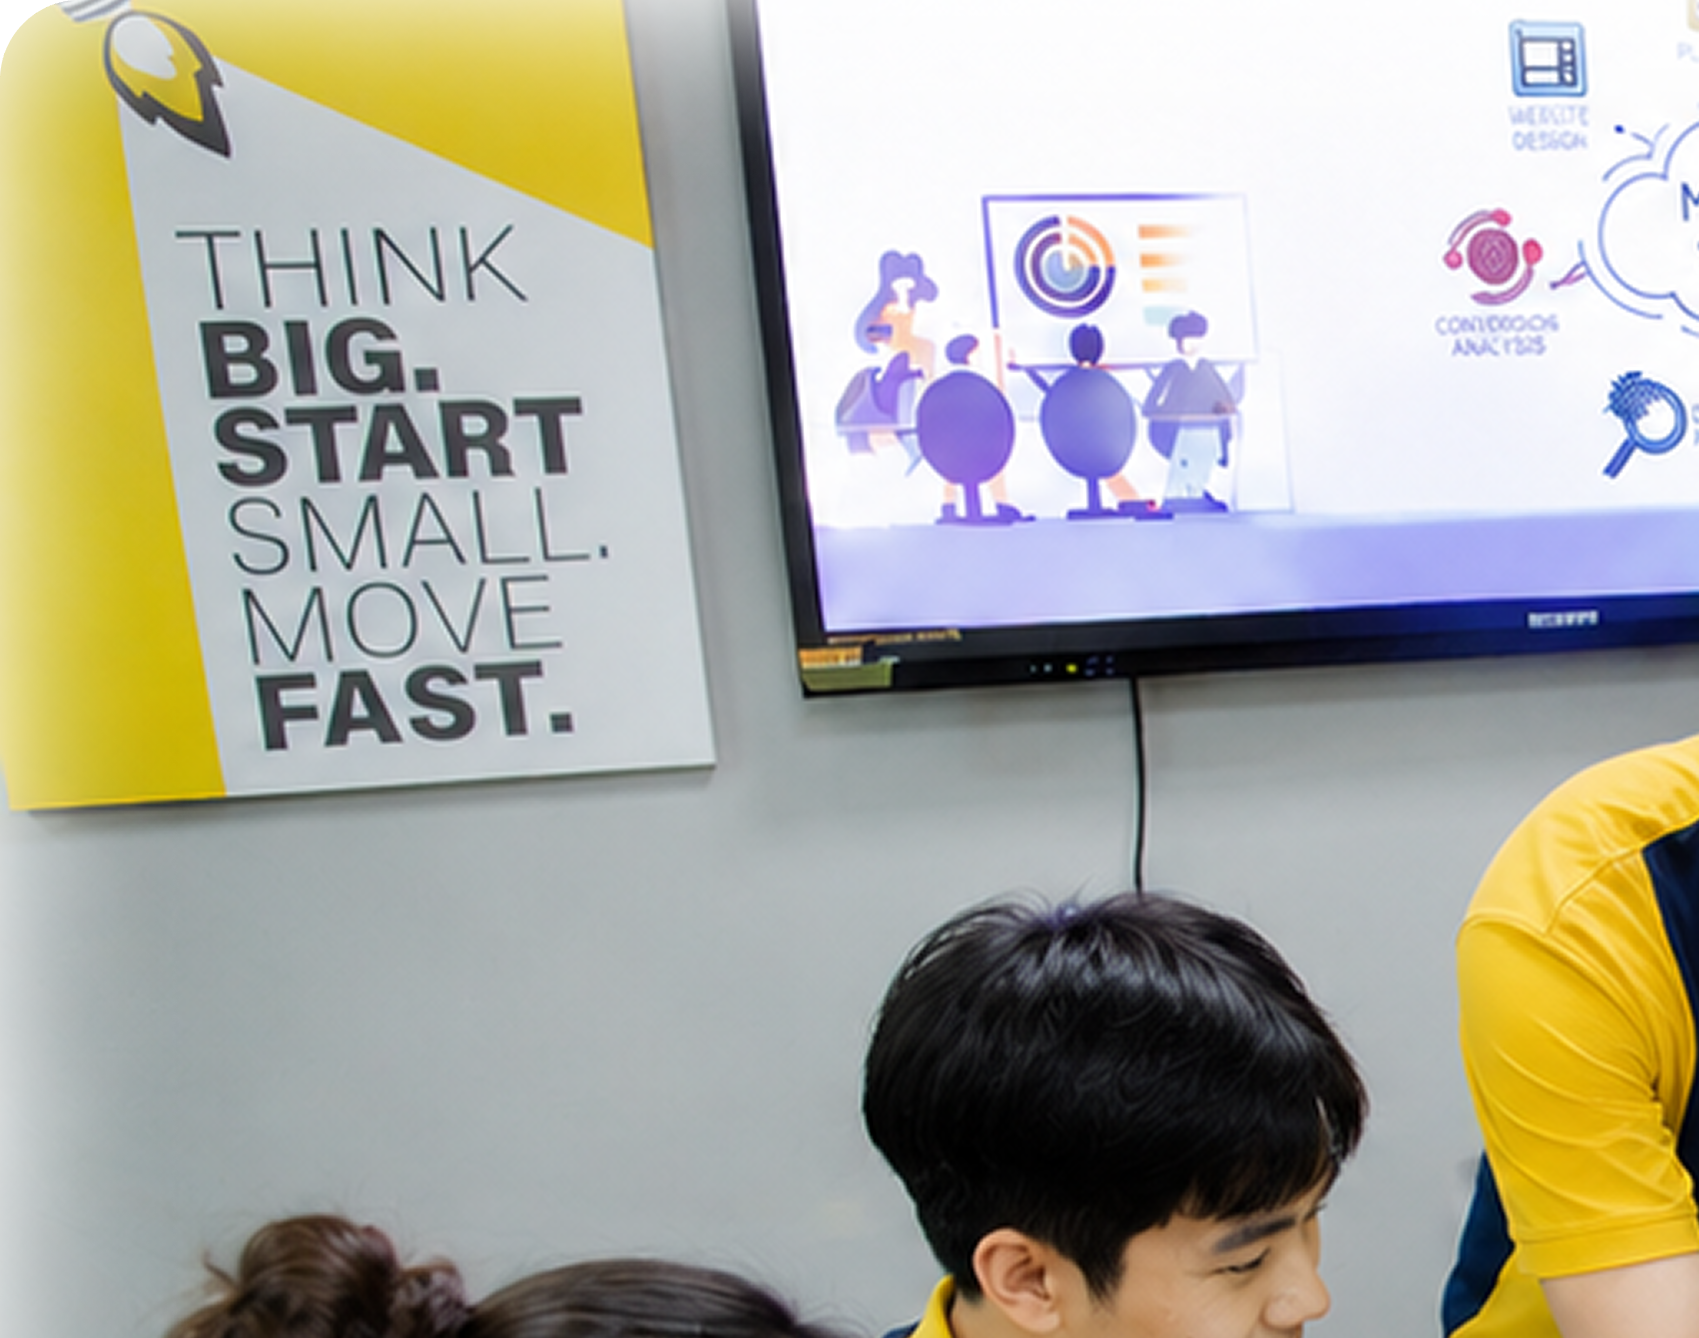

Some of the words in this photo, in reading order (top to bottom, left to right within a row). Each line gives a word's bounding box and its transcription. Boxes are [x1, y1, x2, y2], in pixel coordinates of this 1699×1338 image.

[175, 224, 528, 310] THINK
[200, 317, 440, 399] BIG.
[213, 397, 583, 487] START
[227, 488, 609, 576] SMALL.
[242, 575, 564, 666] MOVE
[255, 661, 574, 752] FAST.
